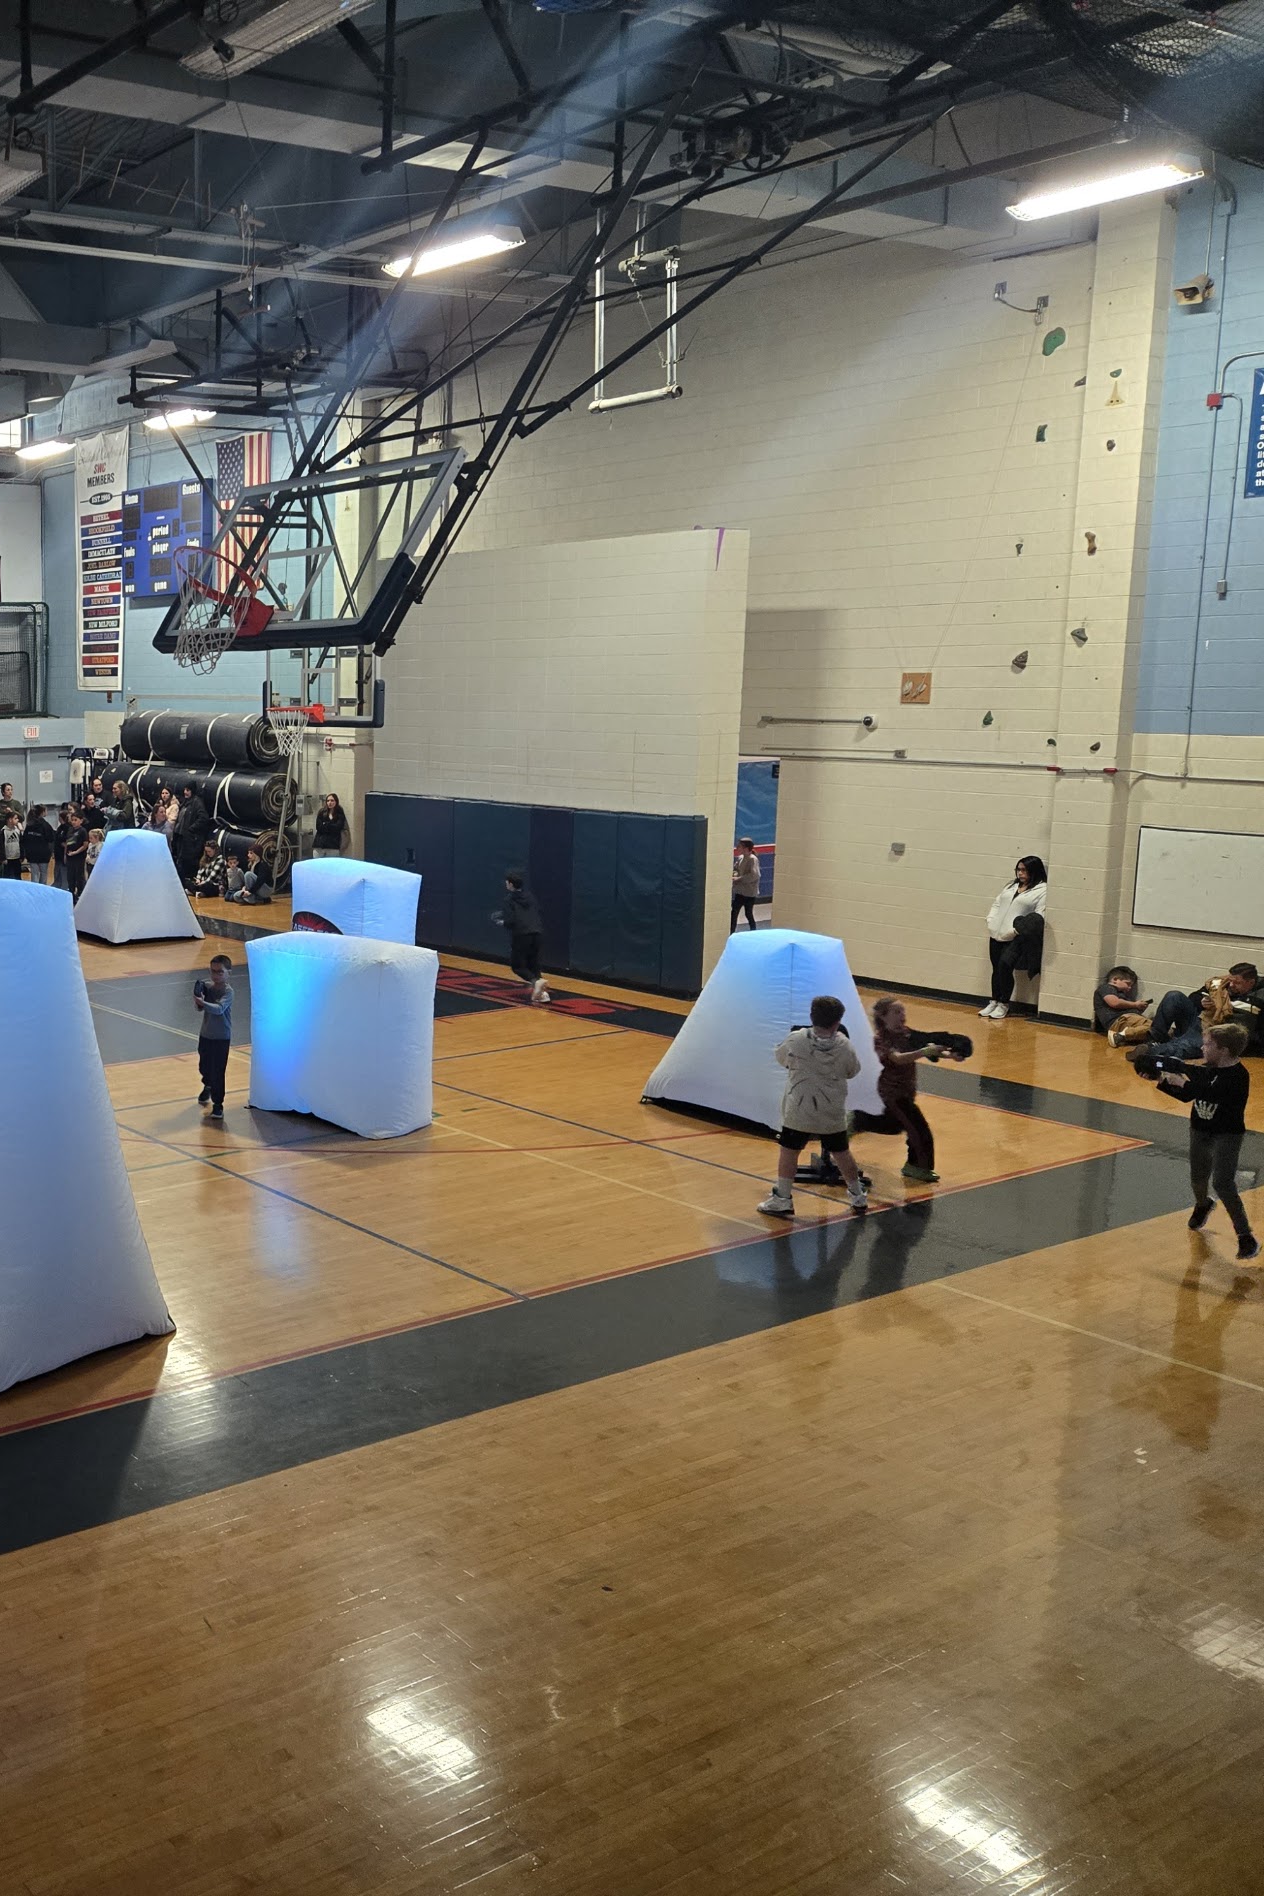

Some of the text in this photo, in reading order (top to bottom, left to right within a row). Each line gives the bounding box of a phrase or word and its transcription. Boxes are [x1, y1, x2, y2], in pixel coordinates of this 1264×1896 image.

[94, 462, 106, 474] SWC
[87, 472, 114, 488] MEMBERS
[182, 484, 200, 496] Guests
[124, 494, 138, 506] Home
[152, 524, 169, 538] period
[152, 542, 169, 555] player
